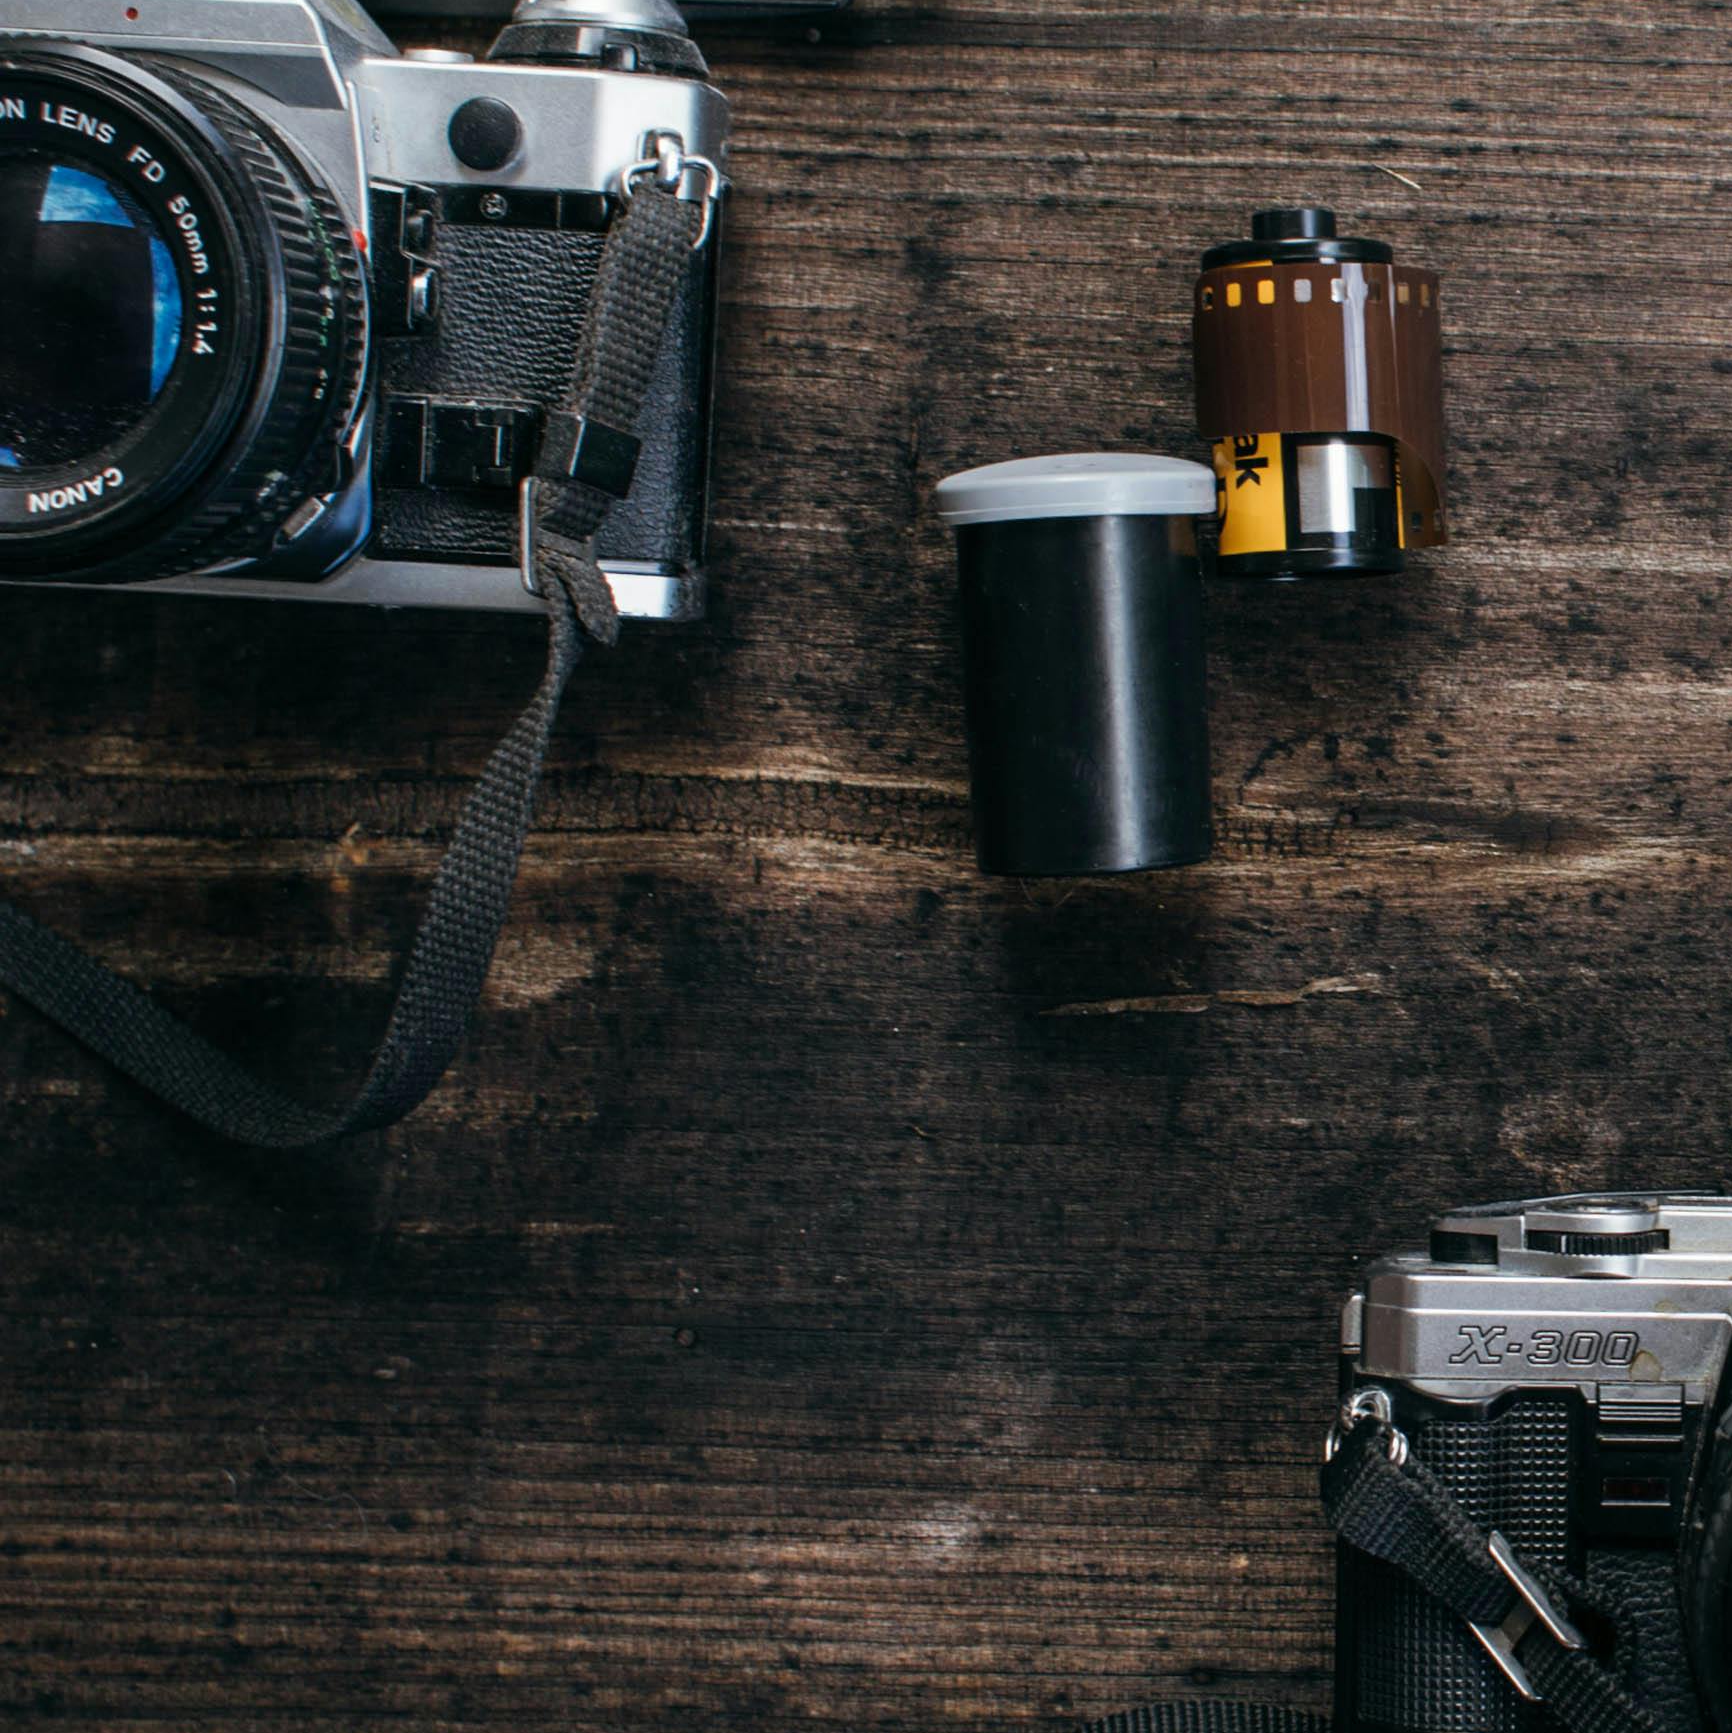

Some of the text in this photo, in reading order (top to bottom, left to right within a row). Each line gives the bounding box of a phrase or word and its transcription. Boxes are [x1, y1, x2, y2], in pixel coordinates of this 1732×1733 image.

[40, 98, 117, 145] LENS
[127, 144, 166, 184] FD
[166, 192, 209, 275] 50mm
[191, 287, 219, 357] 1:1.4
[28, 467, 125, 514] CANON
[1447, 1325, 1640, 1366] X-300
